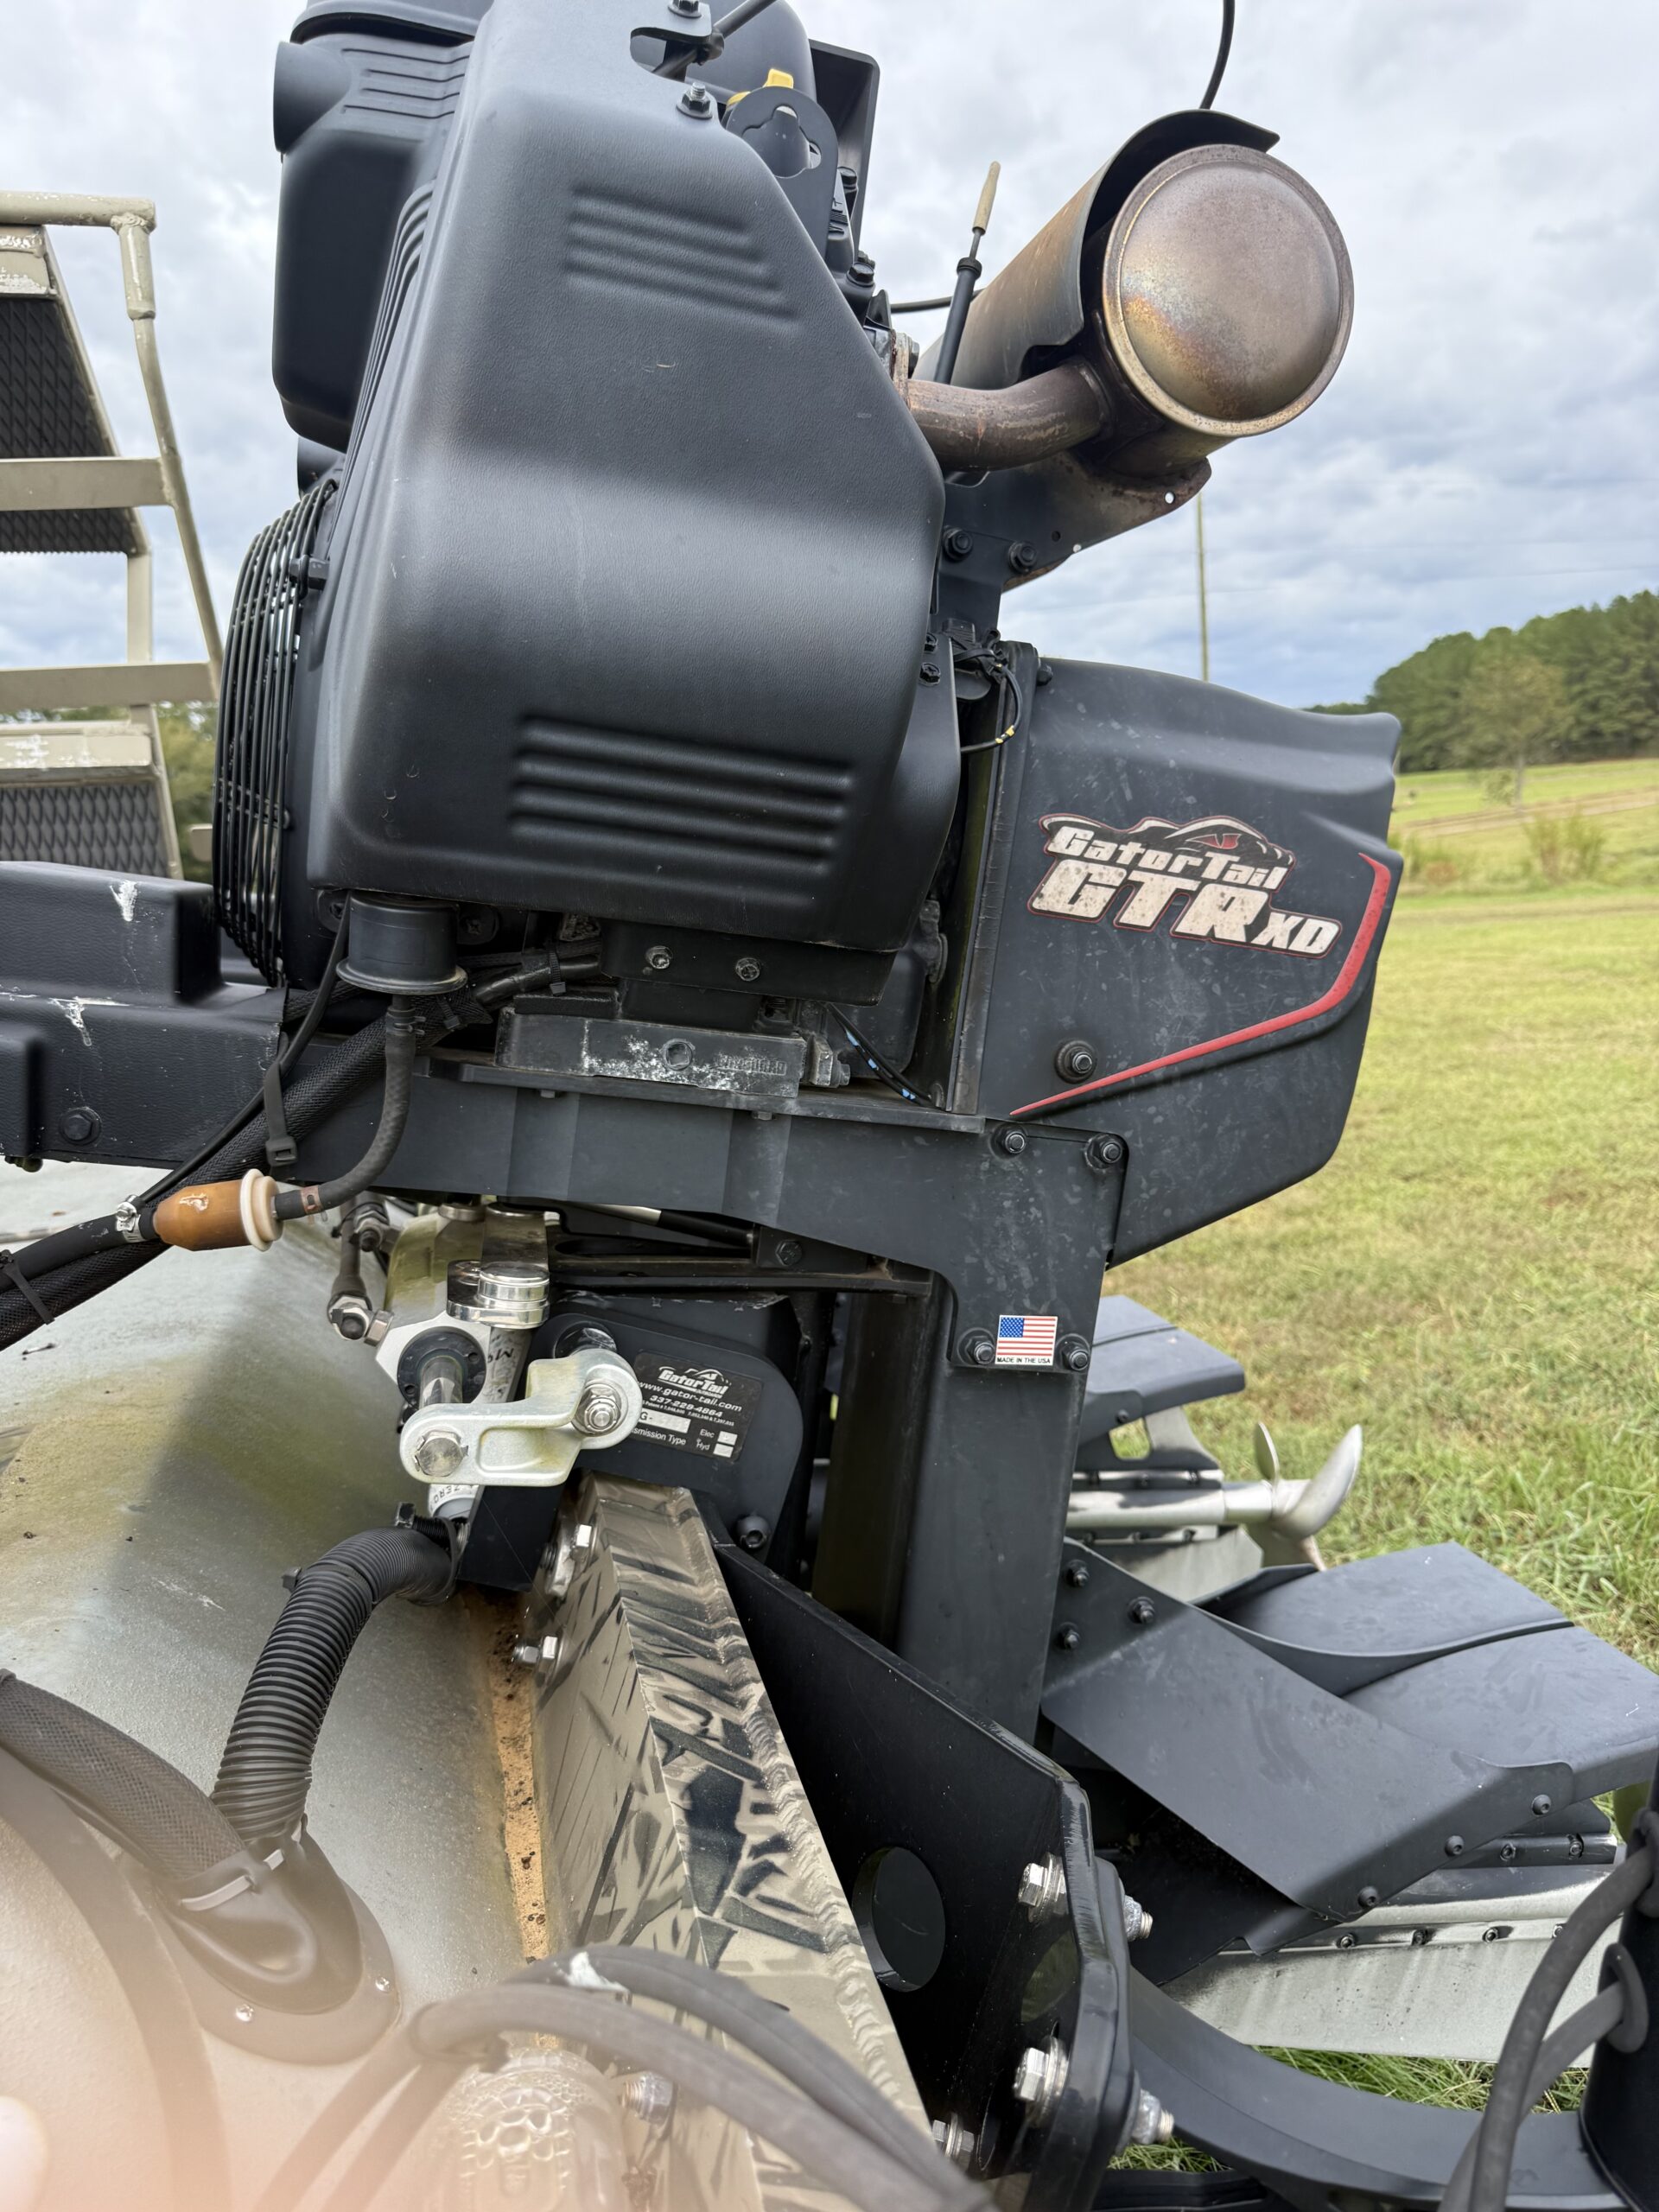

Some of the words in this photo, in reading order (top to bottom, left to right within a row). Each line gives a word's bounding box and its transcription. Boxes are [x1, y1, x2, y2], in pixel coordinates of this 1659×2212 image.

[1047, 825, 1289, 890] GatorTail
[1031, 859, 1269, 943] GTR
[1250, 911, 1340, 955] XD
[658, 1370, 730, 1395] GatorTail
[632, 1427, 666, 1441] smission
[667, 1433, 687, 1446] Type
